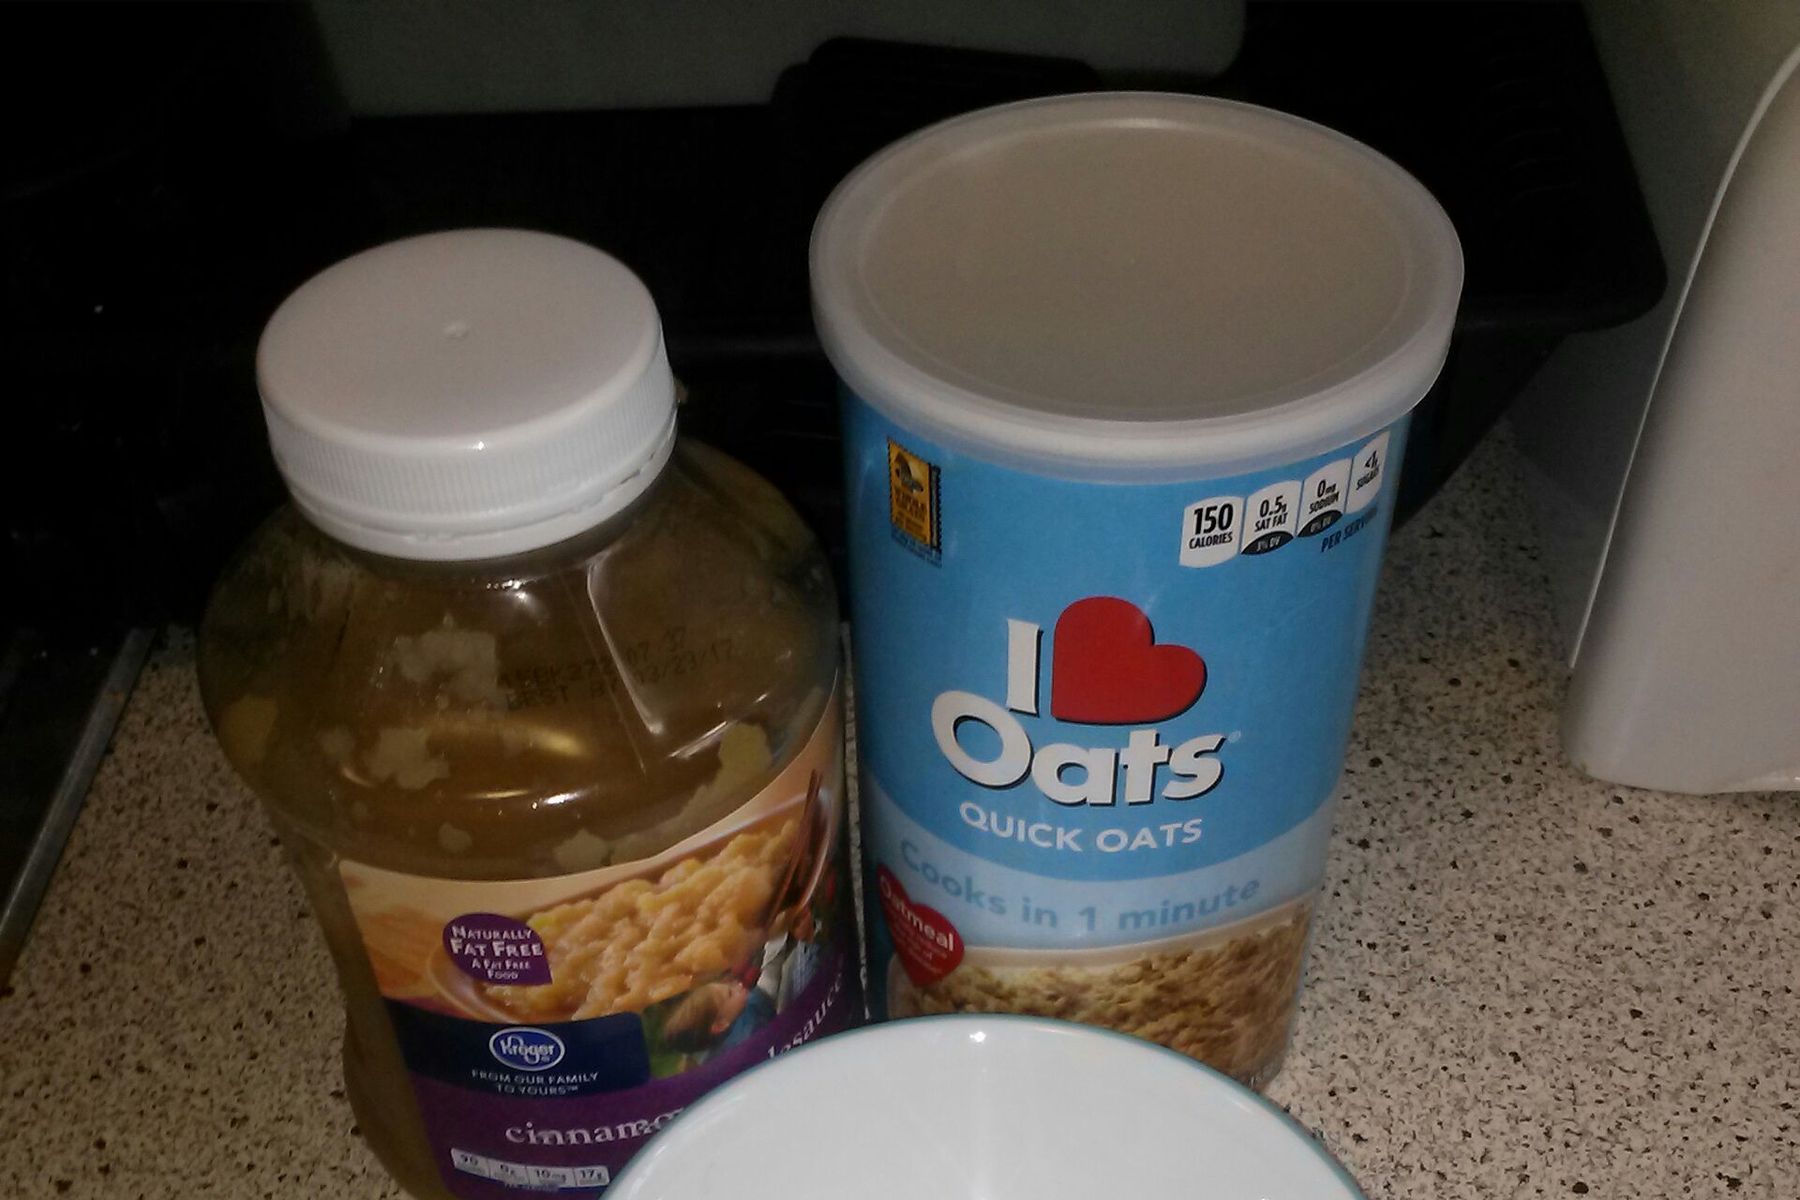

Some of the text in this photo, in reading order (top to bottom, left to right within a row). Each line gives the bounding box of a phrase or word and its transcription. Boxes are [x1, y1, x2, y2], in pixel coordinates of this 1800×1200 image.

[1193, 502, 1235, 536] 150
[1255, 511, 1289, 532] SAT FAT
[1189, 531, 1233, 549] CALORIES
[1321, 530, 1342, 552] PER
[1007, 617, 1043, 717] I
[931, 690, 1226, 807] Oats
[958, 801, 1204, 854] QUICK OATS
[900, 839, 1261, 932] Cooks in 1 minute
[452, 925, 532, 940] NATURALLY
[450, 938, 544, 957] FAT FREE
[499, 1034, 555, 1065] Kroger
[472, 1069, 600, 1084] FROM OUR FAMILY
[497, 1083, 515, 1093] TO
[505, 1107, 684, 1145] cinnamo
